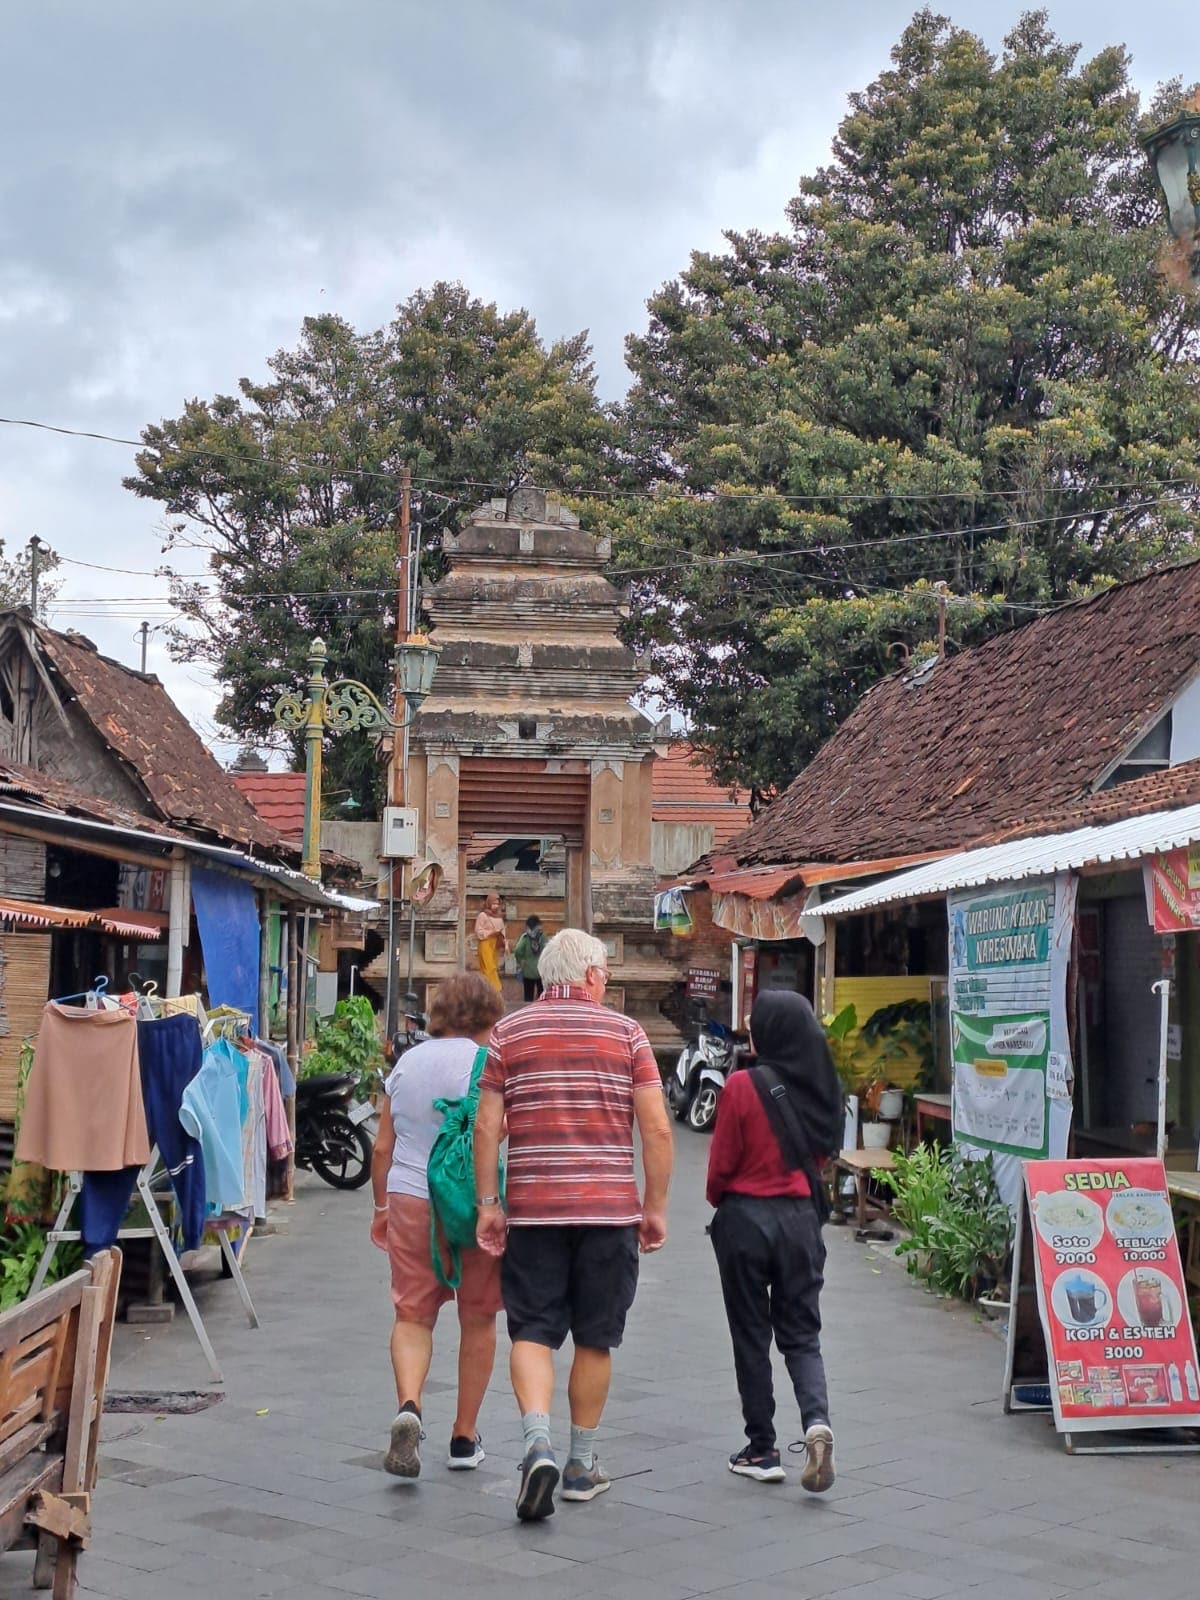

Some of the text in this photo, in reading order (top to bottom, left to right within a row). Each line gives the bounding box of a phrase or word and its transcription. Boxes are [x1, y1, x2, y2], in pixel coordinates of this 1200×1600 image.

[968, 899, 1048, 935] WARUNG MAKAN
[1064, 1171, 1131, 1191] SEDIA
[1053, 1235, 1090, 1248] Soto
[1116, 1238, 1167, 1248] SEBLAK
[1055, 1252, 1096, 1265] 9000
[1122, 1250, 1166, 1261] 10.000
[1065, 1326, 1176, 1341] KOPI & ES TEH
[1104, 1346, 1143, 1360] 3000
